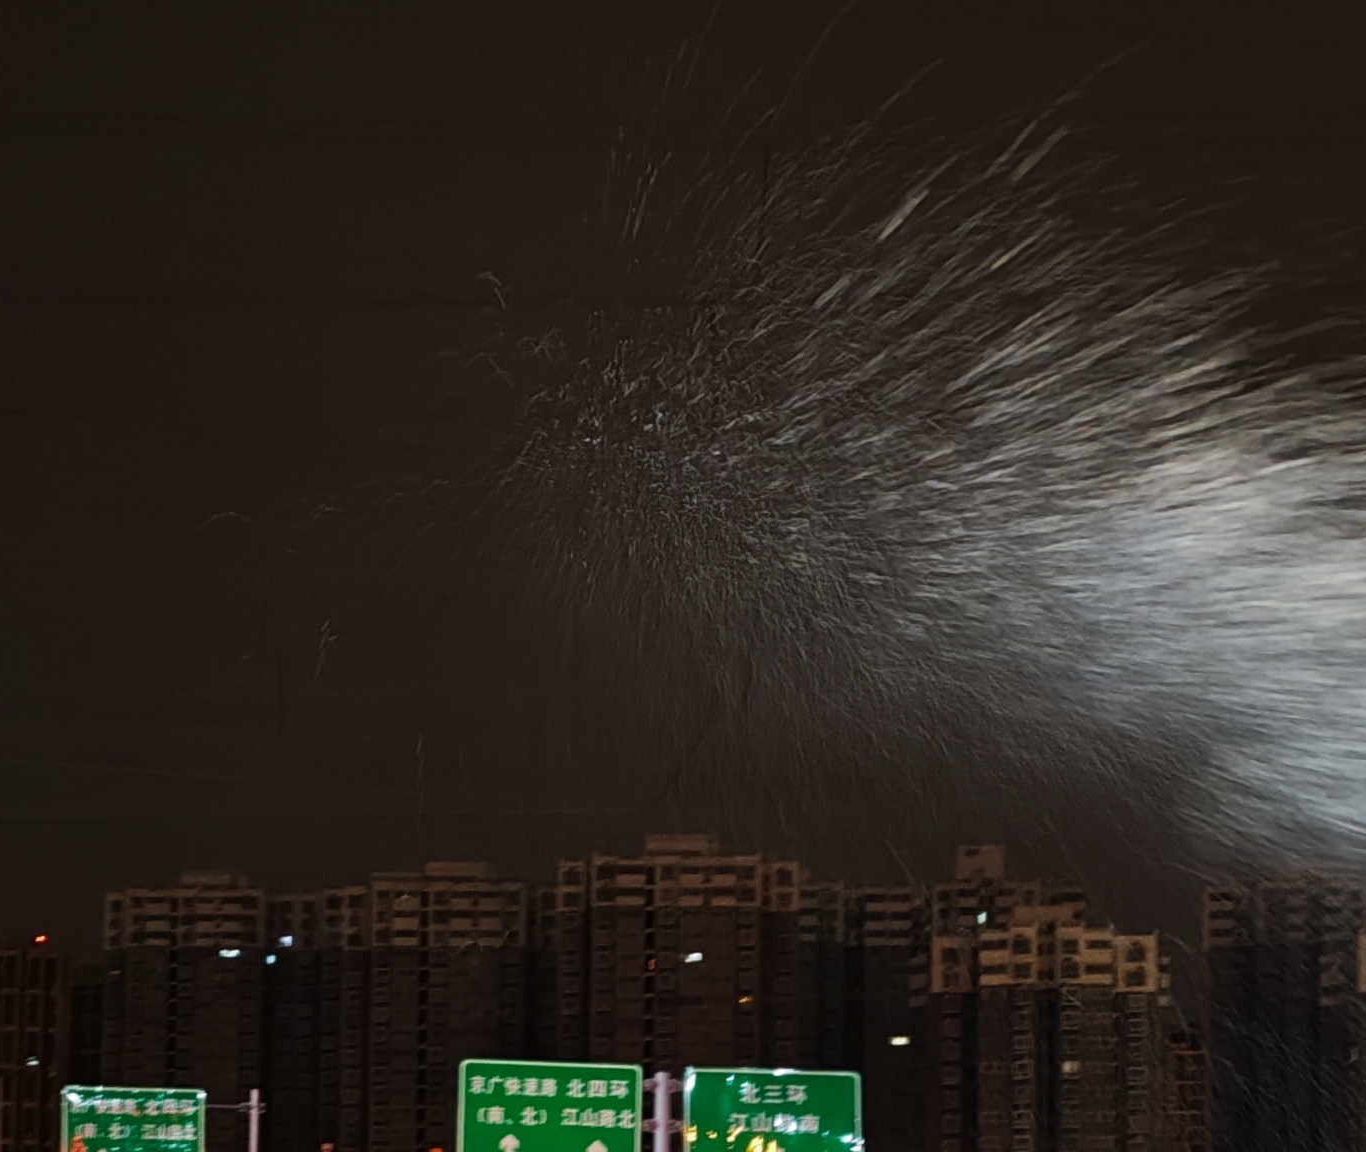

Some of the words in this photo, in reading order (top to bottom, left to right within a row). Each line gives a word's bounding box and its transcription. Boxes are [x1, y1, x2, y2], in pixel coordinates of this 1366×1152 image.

[468, 1075, 558, 1097] 京广快速路
[565, 1078, 631, 1099] 北四环
[738, 1081, 808, 1105] 北三环
[560, 1107, 637, 1129] 江山路北
[726, 1112, 821, 1135] 江山路南
